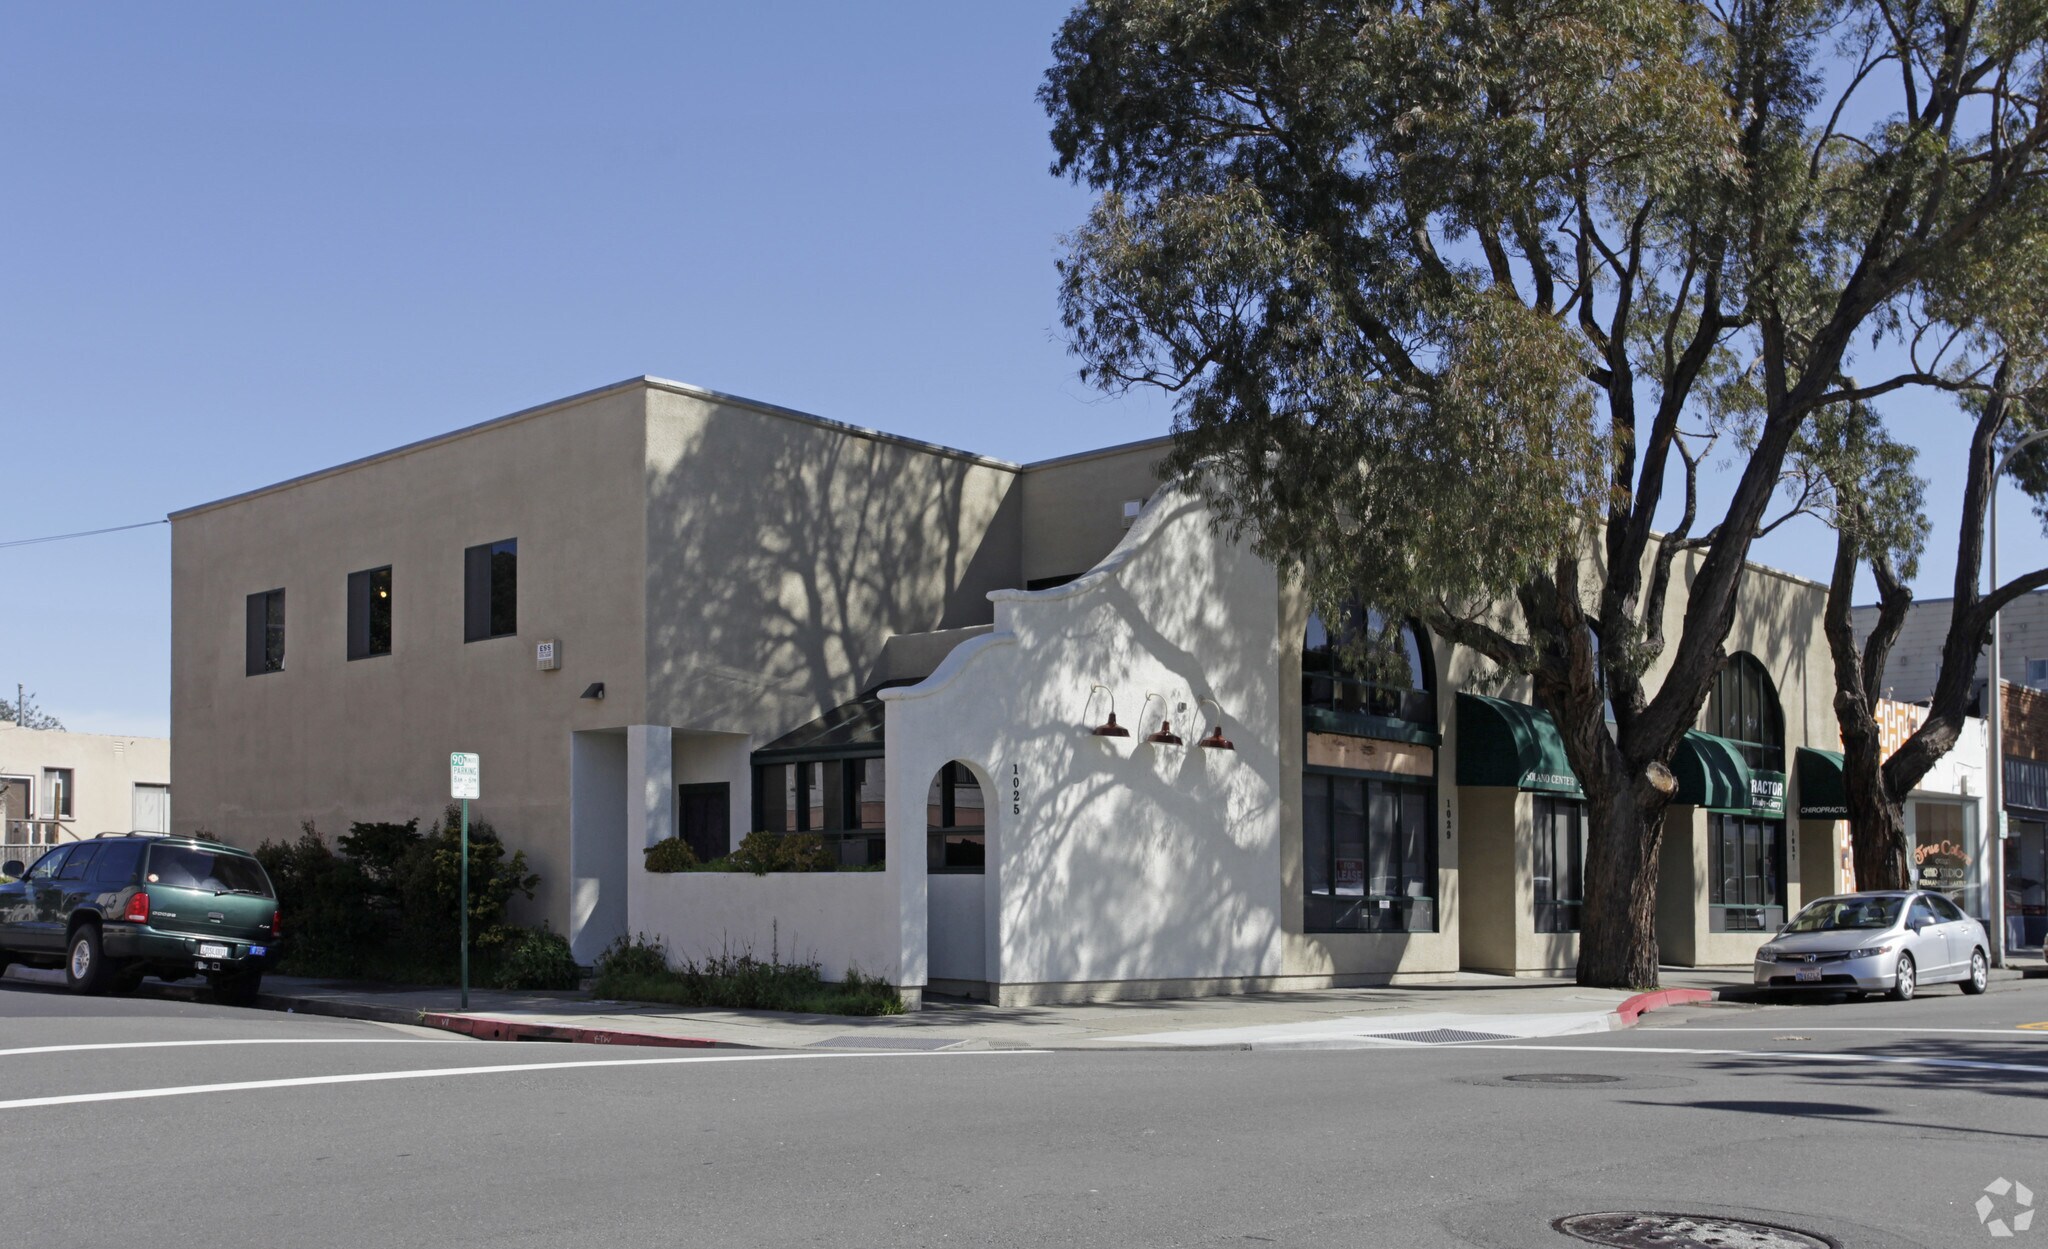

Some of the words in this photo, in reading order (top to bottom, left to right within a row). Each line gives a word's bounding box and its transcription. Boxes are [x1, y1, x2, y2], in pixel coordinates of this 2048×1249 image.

[452, 754, 464, 765] 90
[454, 767, 476, 775] PARKING
[1551, 774, 1575, 786] CENTER
[1751, 779, 1783, 797] RACTOR
[1915, 844, 1939, 864] True
[1343, 861, 1356, 869] FOR
[1337, 869, 1362, 881] LEASE
[1940, 868, 1963, 878] STUDIO
